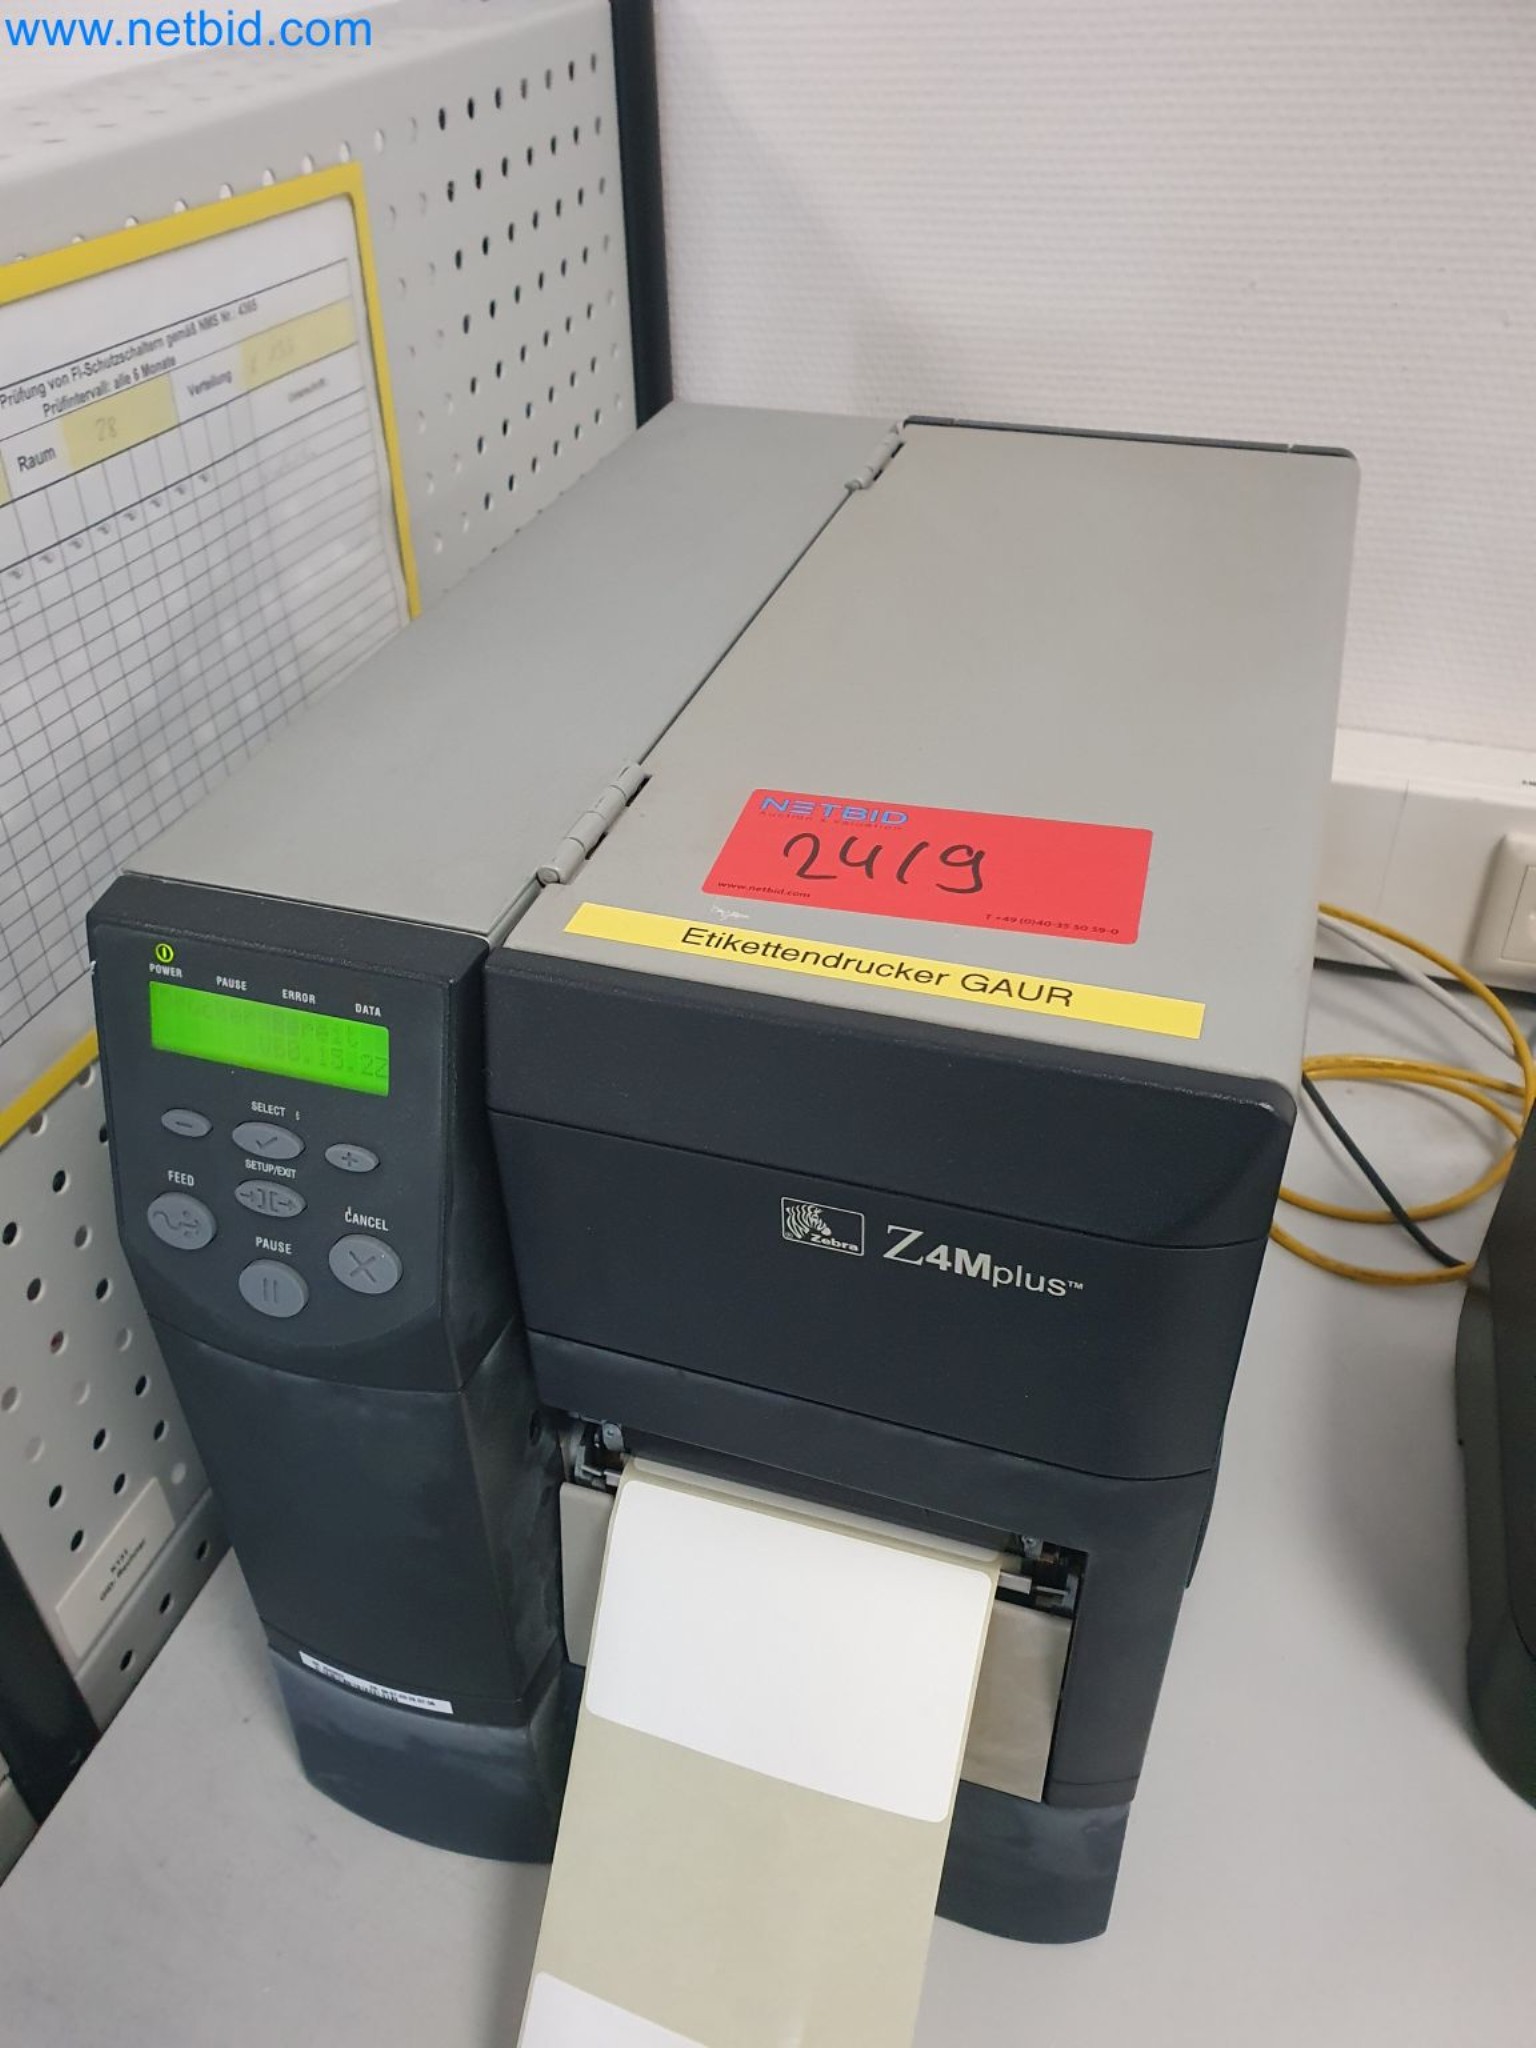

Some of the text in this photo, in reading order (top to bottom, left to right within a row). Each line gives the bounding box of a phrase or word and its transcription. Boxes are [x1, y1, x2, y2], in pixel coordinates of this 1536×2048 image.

[114, 373, 131, 389] alle
[140, 356, 176, 377] Monate
[0, 382, 47, 408] Prüfung
[47, 374, 70, 390] von
[17, 447, 56, 472] Raum
[760, 797, 908, 826] NETBID
[718, 881, 811, 898] www.netbid.com
[149, 963, 182, 978] POWER
[681, 927, 1073, 1007] Etikettendrucker GAUR
[216, 975, 247, 991] PAUSE
[282, 989, 315, 1004] ERROR
[355, 1003, 381, 1017] DATA
[251, 1101, 286, 1117] SELECT
[245, 1159, 296, 1179] SETUP/EXIT
[168, 1170, 195, 1187] FEED
[345, 1210, 388, 1231] CANCEL
[256, 1237, 292, 1254] PAUSE
[810, 1233, 858, 1251] Zebra
